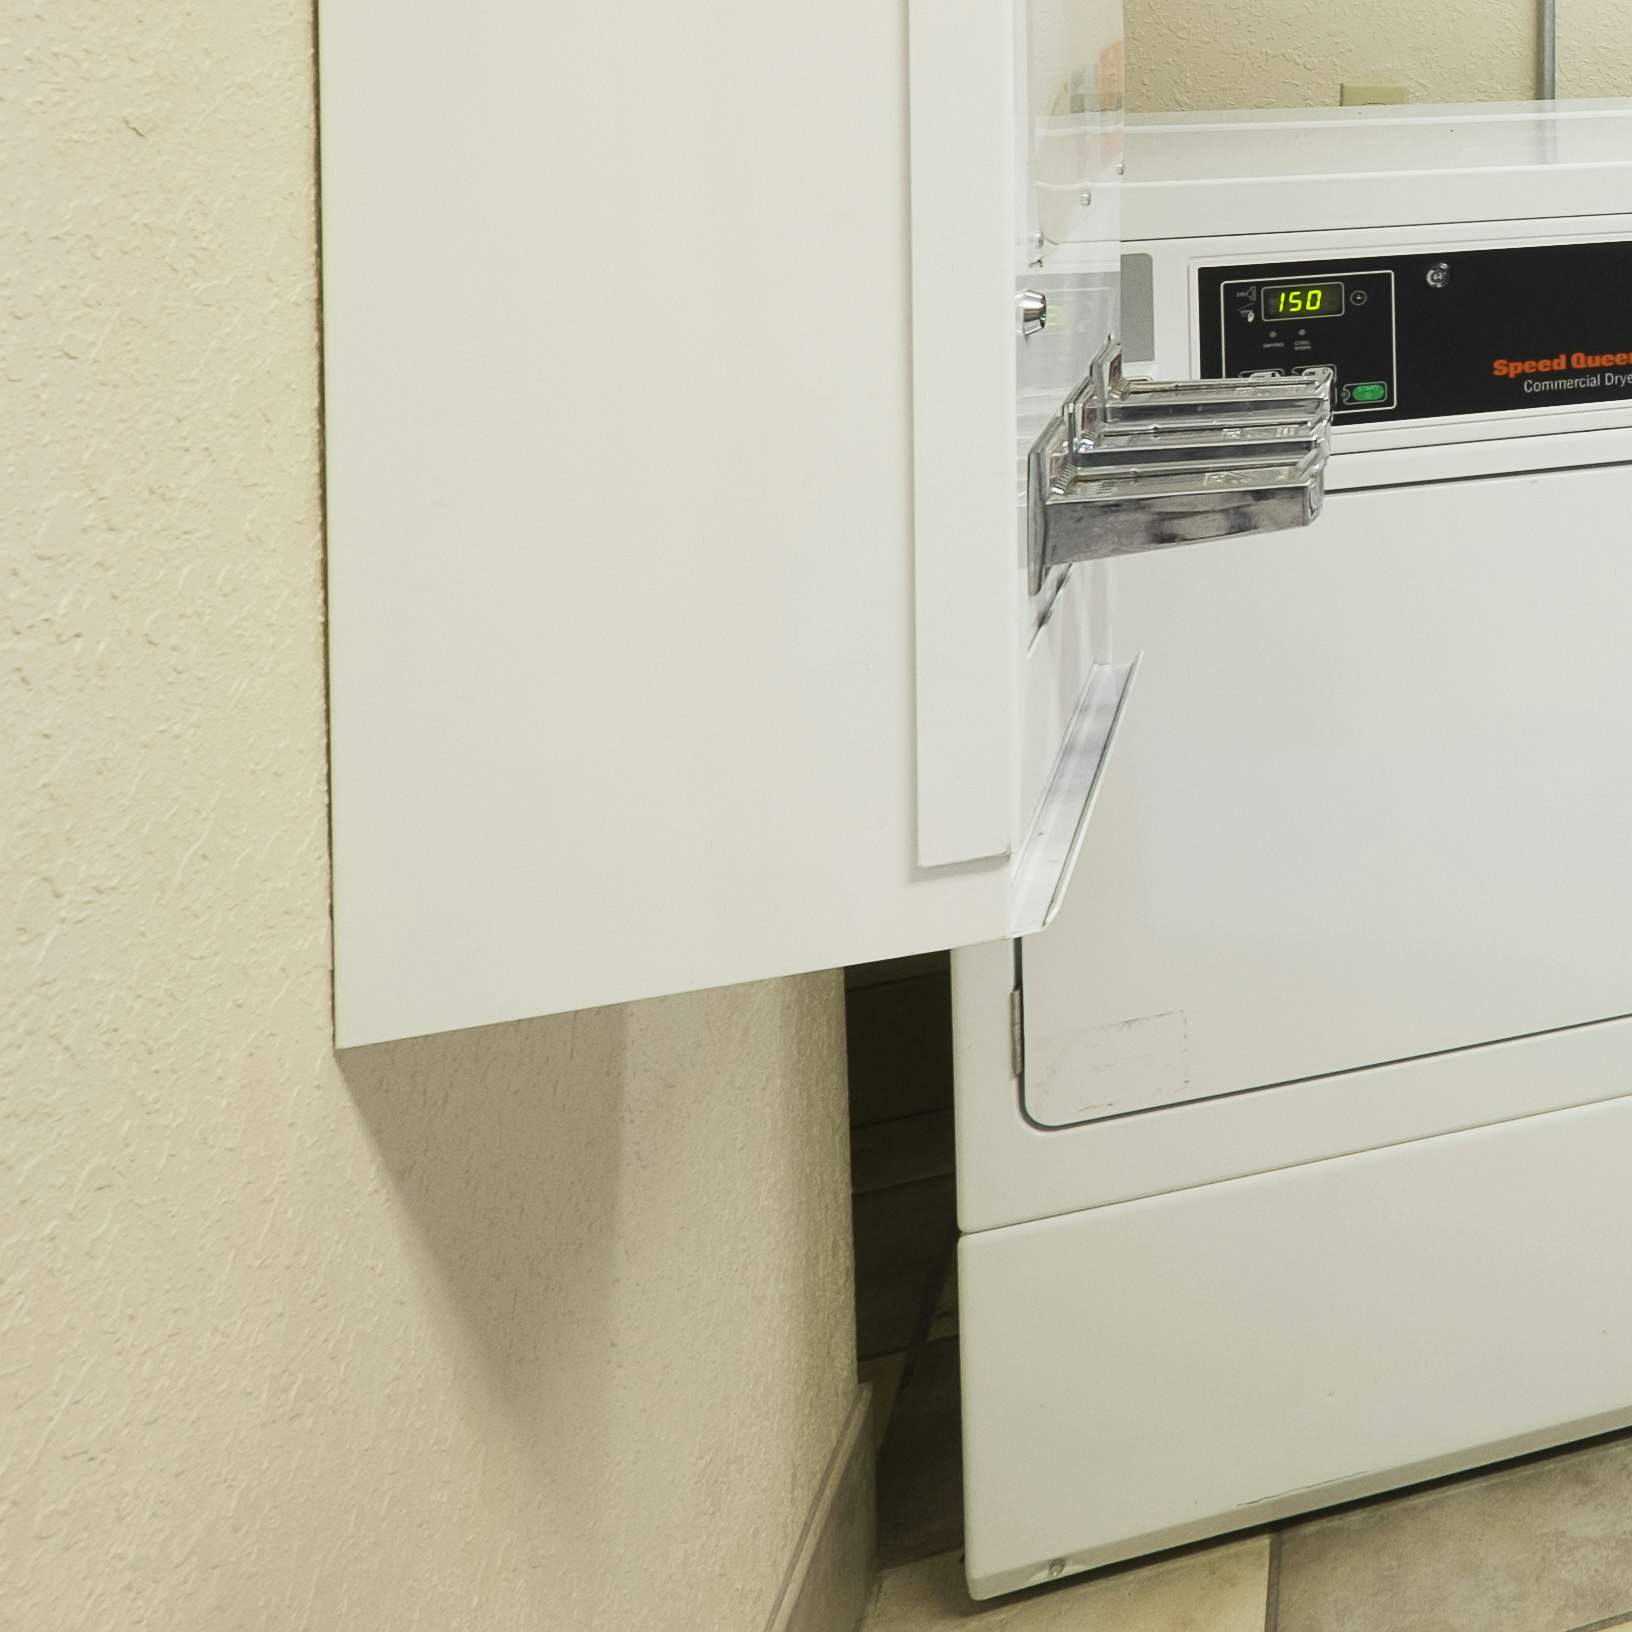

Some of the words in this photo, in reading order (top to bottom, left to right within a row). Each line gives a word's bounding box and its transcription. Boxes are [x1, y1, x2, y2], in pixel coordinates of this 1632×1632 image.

[1279, 290, 1322, 312] 150
[1492, 354, 1567, 379] Speed
[1524, 374, 1600, 393] Commercial
